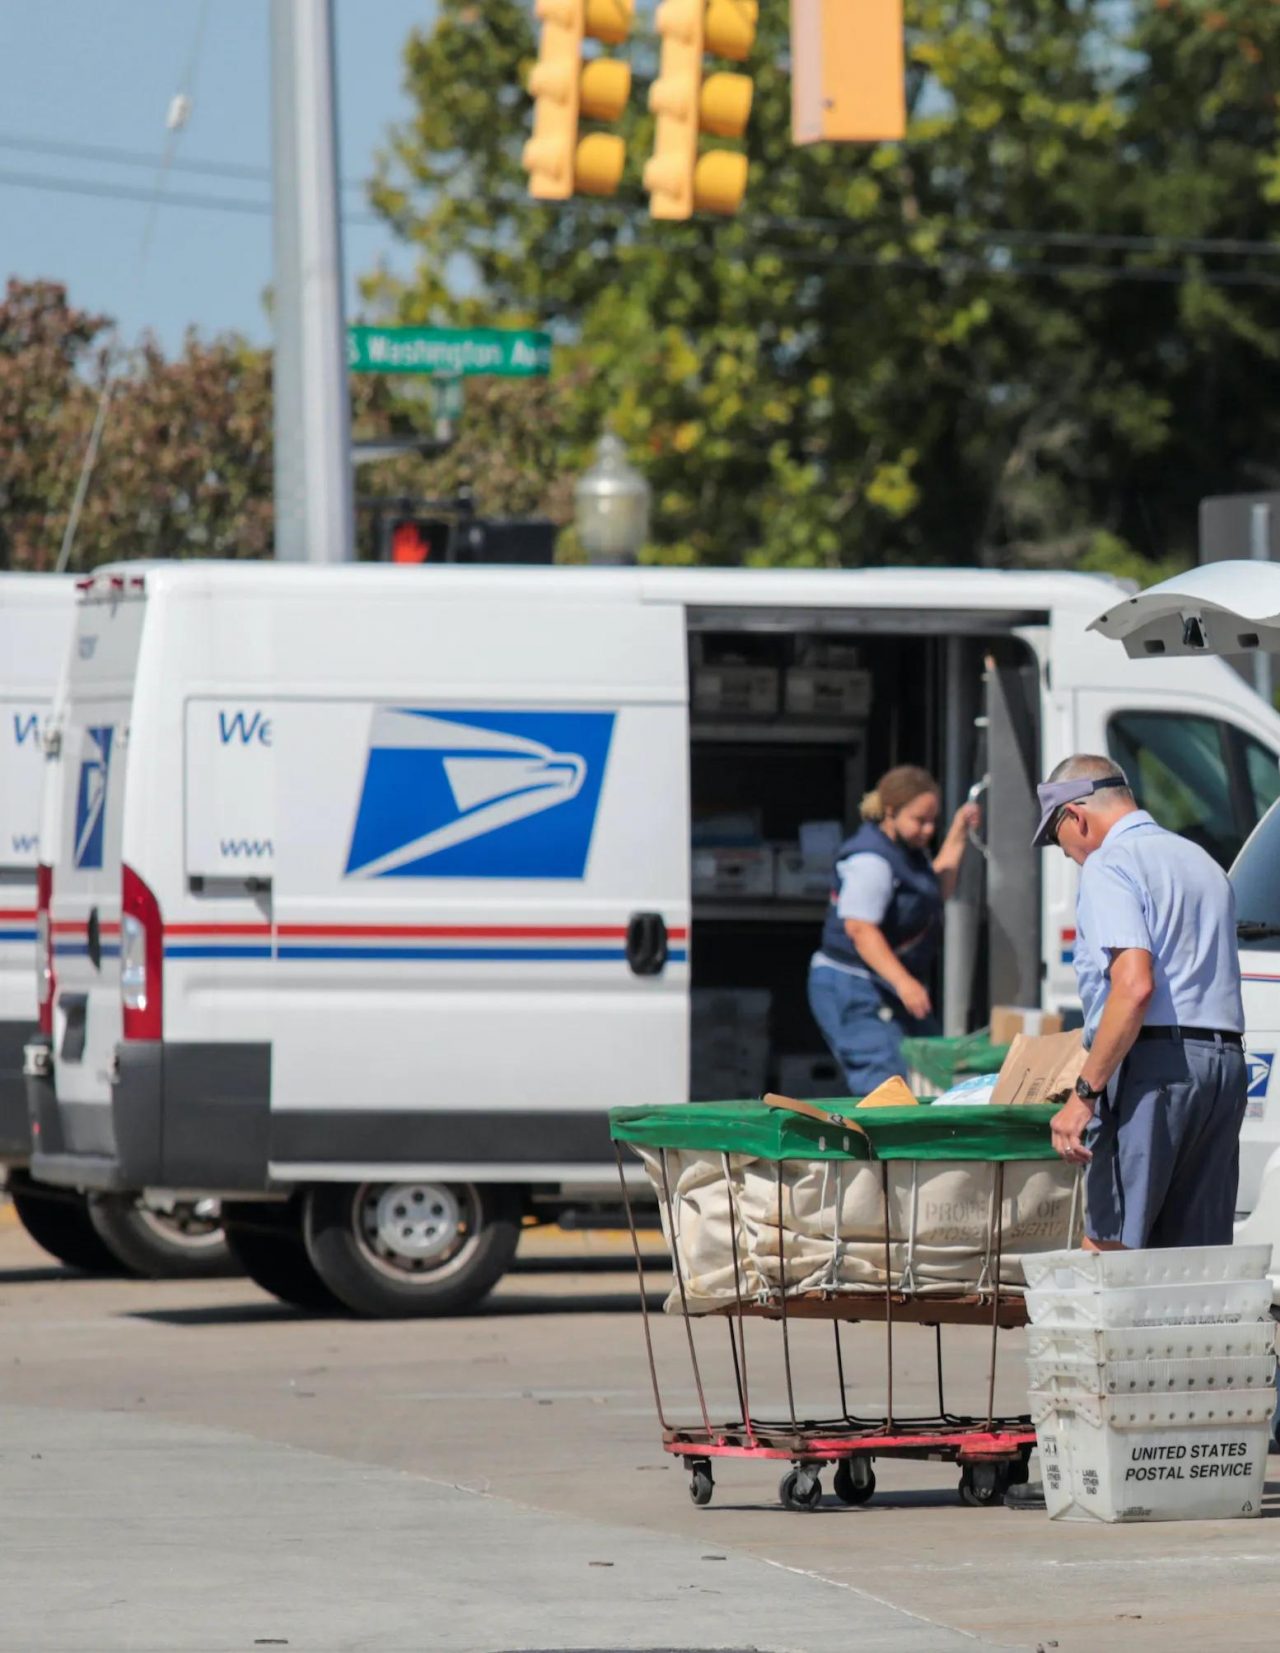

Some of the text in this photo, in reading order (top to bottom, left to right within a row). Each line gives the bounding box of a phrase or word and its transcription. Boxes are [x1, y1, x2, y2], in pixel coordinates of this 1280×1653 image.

[368, 336, 502, 370] Washington
[219, 710, 273, 746] We
[1131, 1442, 1248, 1461] UNITED STATES
[1081, 1469, 1099, 1478] LABEL
[1125, 1462, 1253, 1481] POSTAL SERVICE
